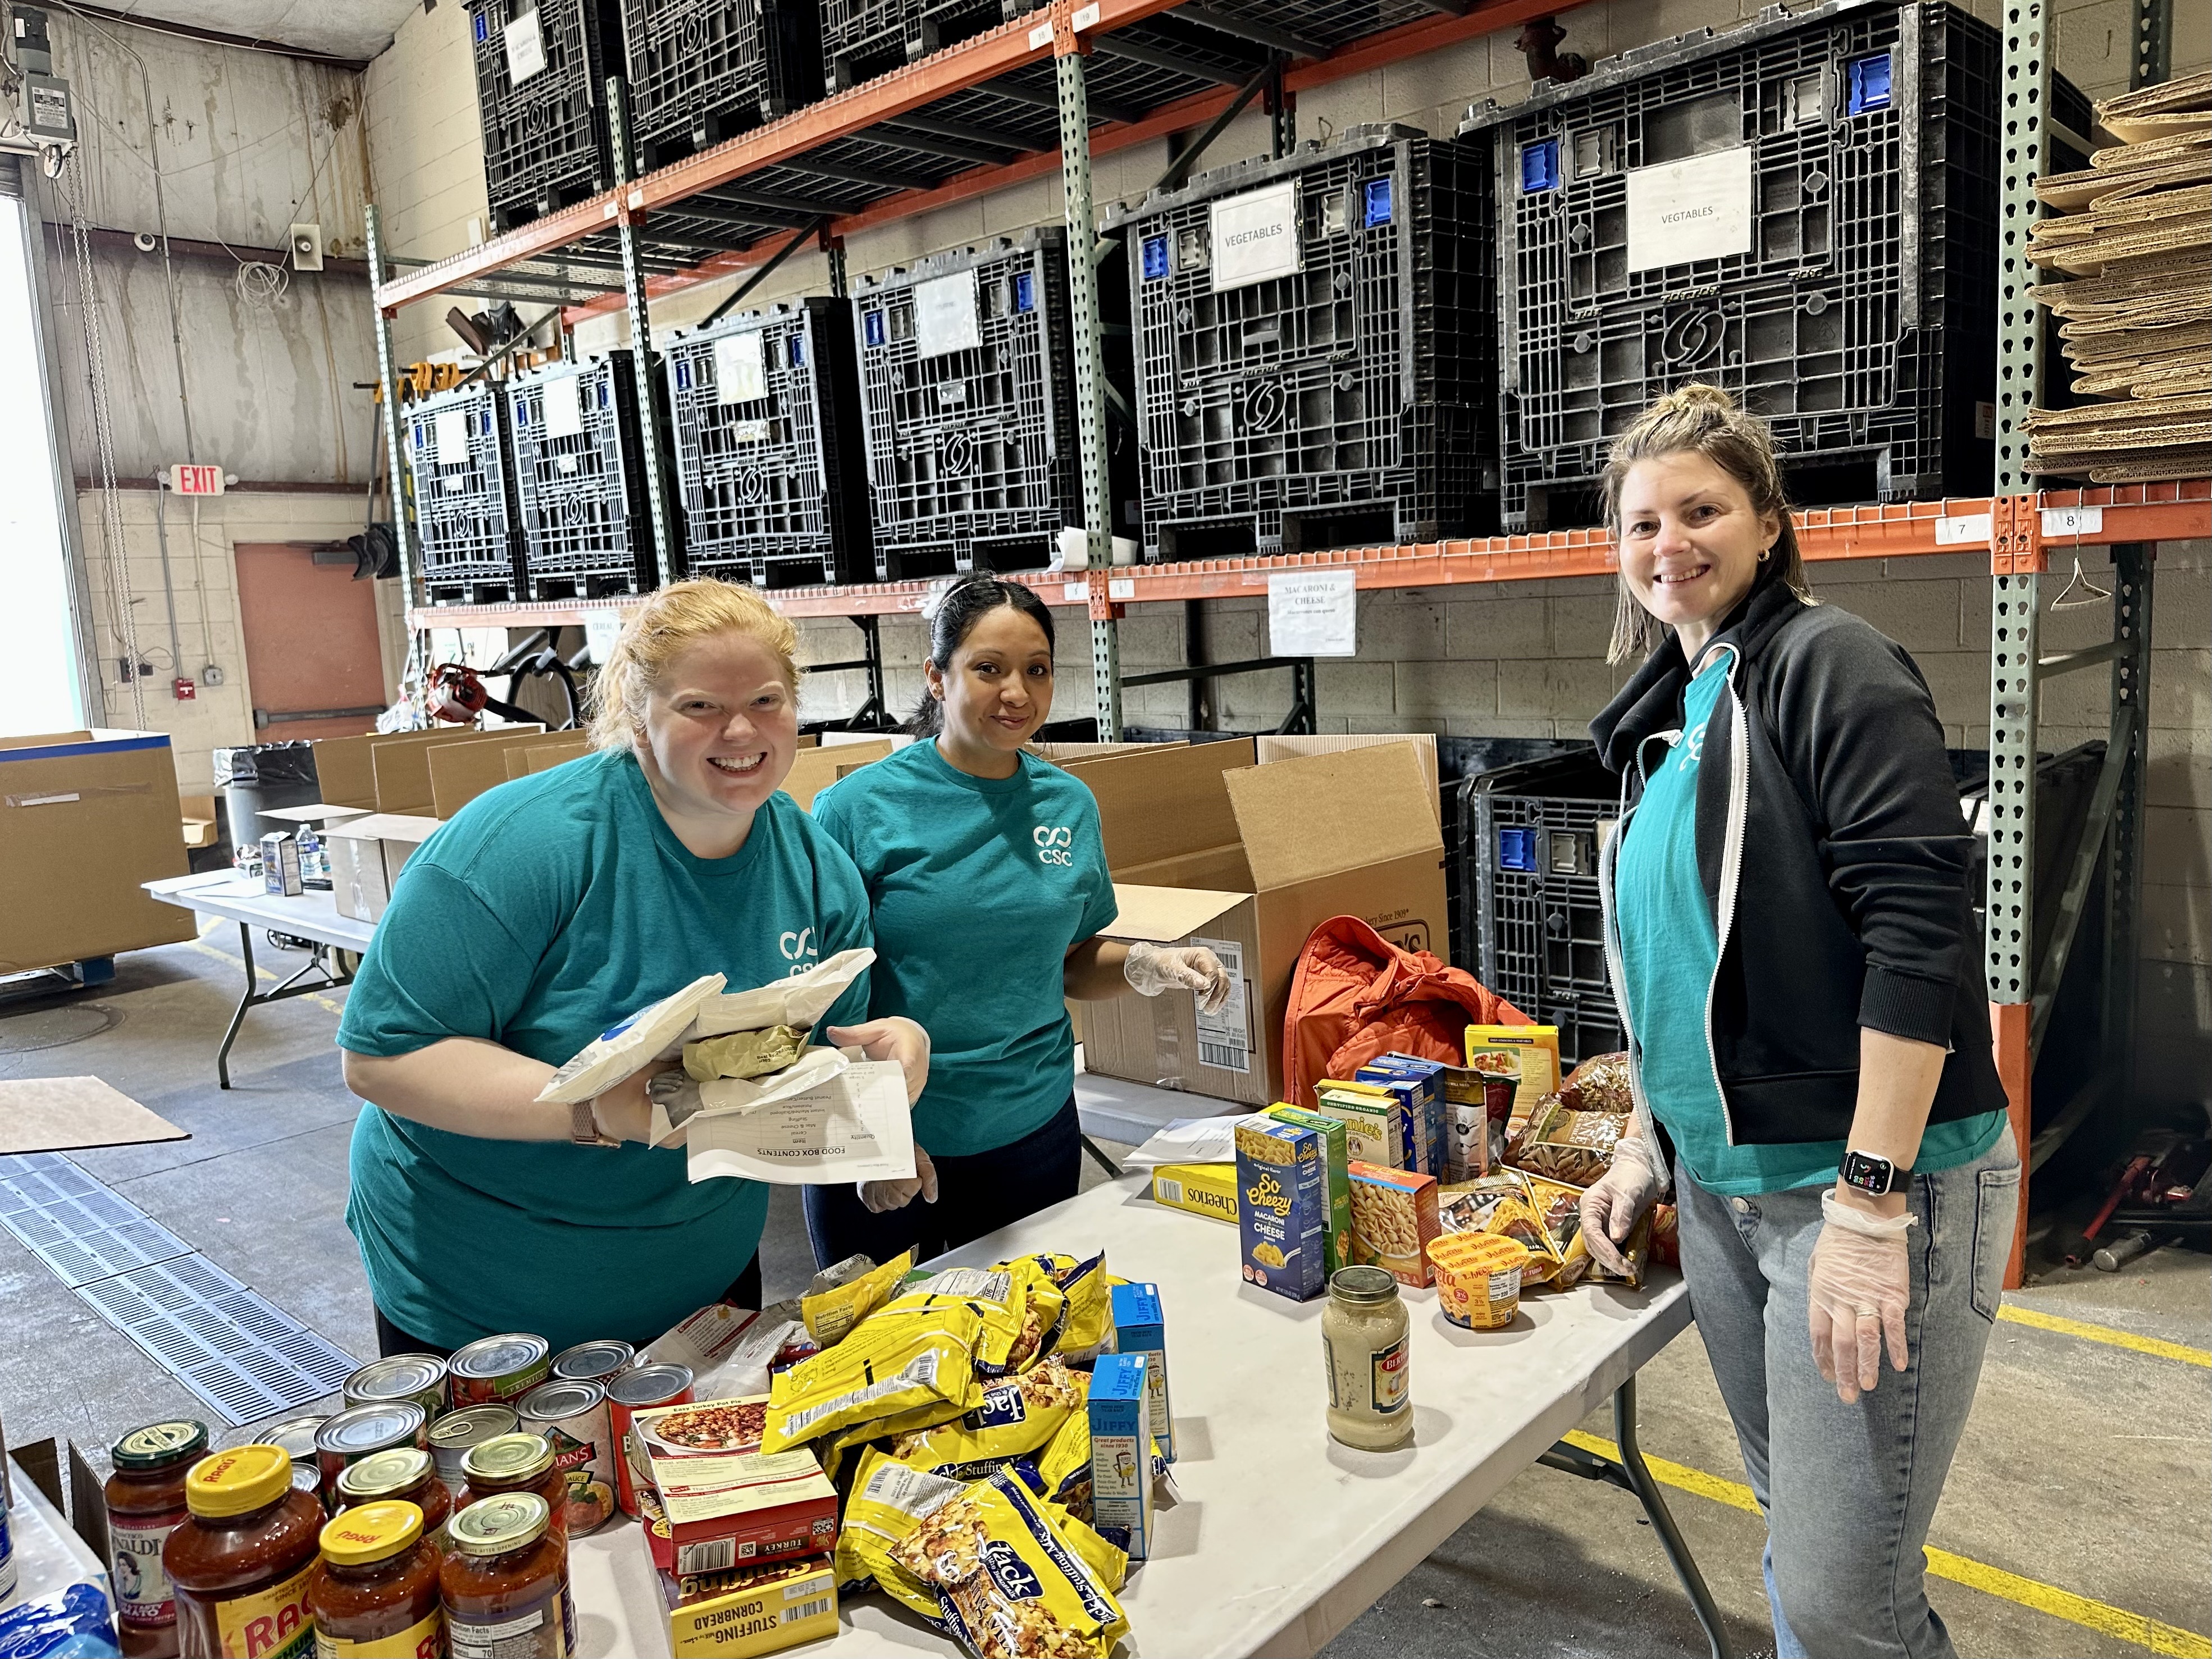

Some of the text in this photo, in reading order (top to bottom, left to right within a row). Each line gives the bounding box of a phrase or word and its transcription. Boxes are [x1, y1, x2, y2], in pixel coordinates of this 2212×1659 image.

[1662, 206, 1713, 223] VEGTABLES
[1225, 223, 1283, 247] VEGETABLES
[180, 467, 216, 493] EXIT
[2067, 516, 2074, 526] 8
[1959, 524, 1965, 534] 7
[1285, 584, 1327, 593] MACARONI
[1295, 596, 1325, 605] CHEESE
[1038, 849, 1073, 867] CSC
[1379, 913, 1393, 922] Since
[1326, 1101, 1379, 1114] CERTIFIED ORGANIC
[1568, 1123, 1581, 1143] WHEAT
[757, 1148, 800, 1157] CONTENTS
[1302, 1142, 1312, 1153] So
[1297, 1148, 1319, 1163] Cheezy
[1253, 1163, 1269, 1172] original
[1302, 1166, 1316, 1176] CHEESE
[1258, 1173, 1281, 1194] So
[1188, 1188, 1237, 1215] Cheerios
[1246, 1188, 1292, 1217] Cheezy
[1254, 1210, 1285, 1226] MACARONI
[1253, 1222, 1285, 1240] CHEESE
[1470, 1238, 1501, 1250] Velveeta
[1433, 1248, 1463, 1260] Velveeta
[1485, 1246, 1516, 1259] Velveeta
[1448, 1256, 1479, 1268] Velveeta
[1529, 1265, 1543, 1276] TUNA
[985, 1288, 993, 1297] 90
[1000, 1286, 1009, 1301] Facts
[815, 1304, 854, 1320] Nutrition Facts
[1136, 1297, 1151, 1322] JIFFY
[817, 1324, 838, 1333] Calories
[509, 1370, 545, 1392] PREMIUM
[1111, 1368, 1132, 1395] JIFFY
[1091, 1418, 1136, 1432] JIFFY
[203, 1457, 237, 1482] RAGÚ
[567, 1474, 586, 1483] AUCE
[706, 1482, 735, 1491] Ultimate
[736, 1478, 763, 1487] Leftover
[787, 1466, 820, 1479] Sandwich
[335, 1529, 383, 1544] RAGÚ
[1038, 1532, 1059, 1555] Mix
[497, 1540, 522, 1552] OPENING
[764, 1539, 802, 1552] TURKEY
[988, 1541, 1036, 1598] Jack
[1056, 1551, 1089, 1592] Stuffing
[987, 1558, 1016, 1598] the Beanstalk
[275, 1587, 297, 1602] SINCE
[694, 1601, 764, 1630] CORNBREAD
[471, 1626, 490, 1635] Facts
[715, 1615, 777, 1643] STUFFING
[482, 1649, 492, 1658] 70
